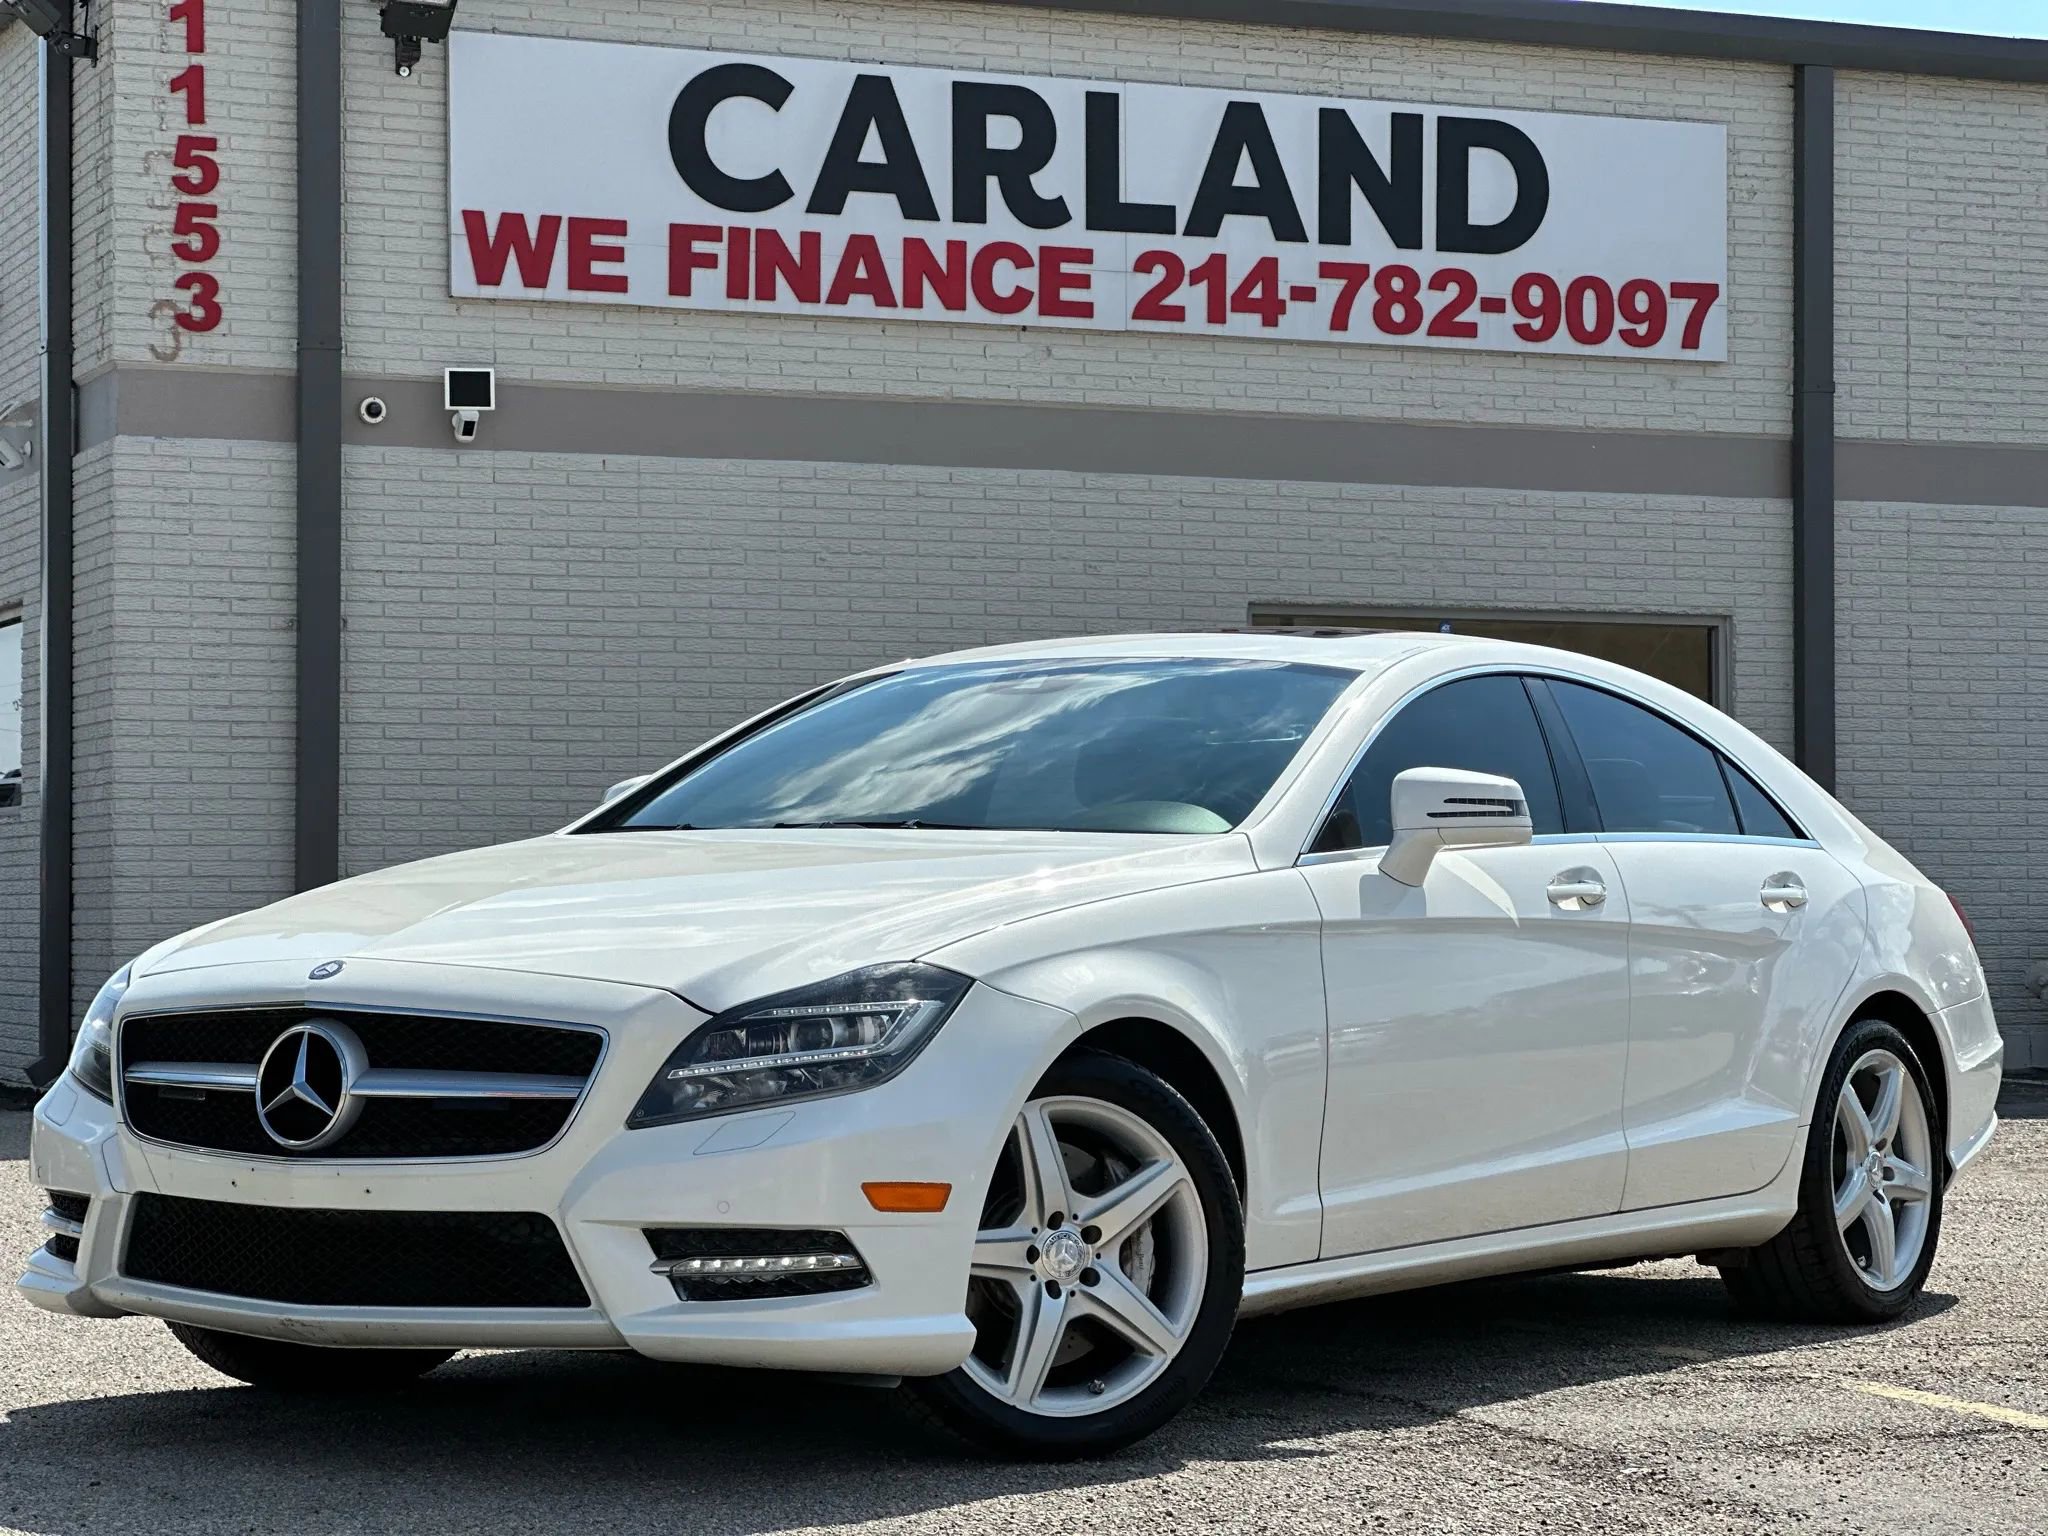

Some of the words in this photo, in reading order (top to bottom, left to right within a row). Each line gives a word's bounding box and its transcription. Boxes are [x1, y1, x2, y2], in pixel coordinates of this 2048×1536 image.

[668, 62, 1550, 255] CARLAND
[461, 209, 628, 293] WE
[669, 223, 1094, 319] FINANCE
[1132, 249, 1719, 350] 214-782-9097
